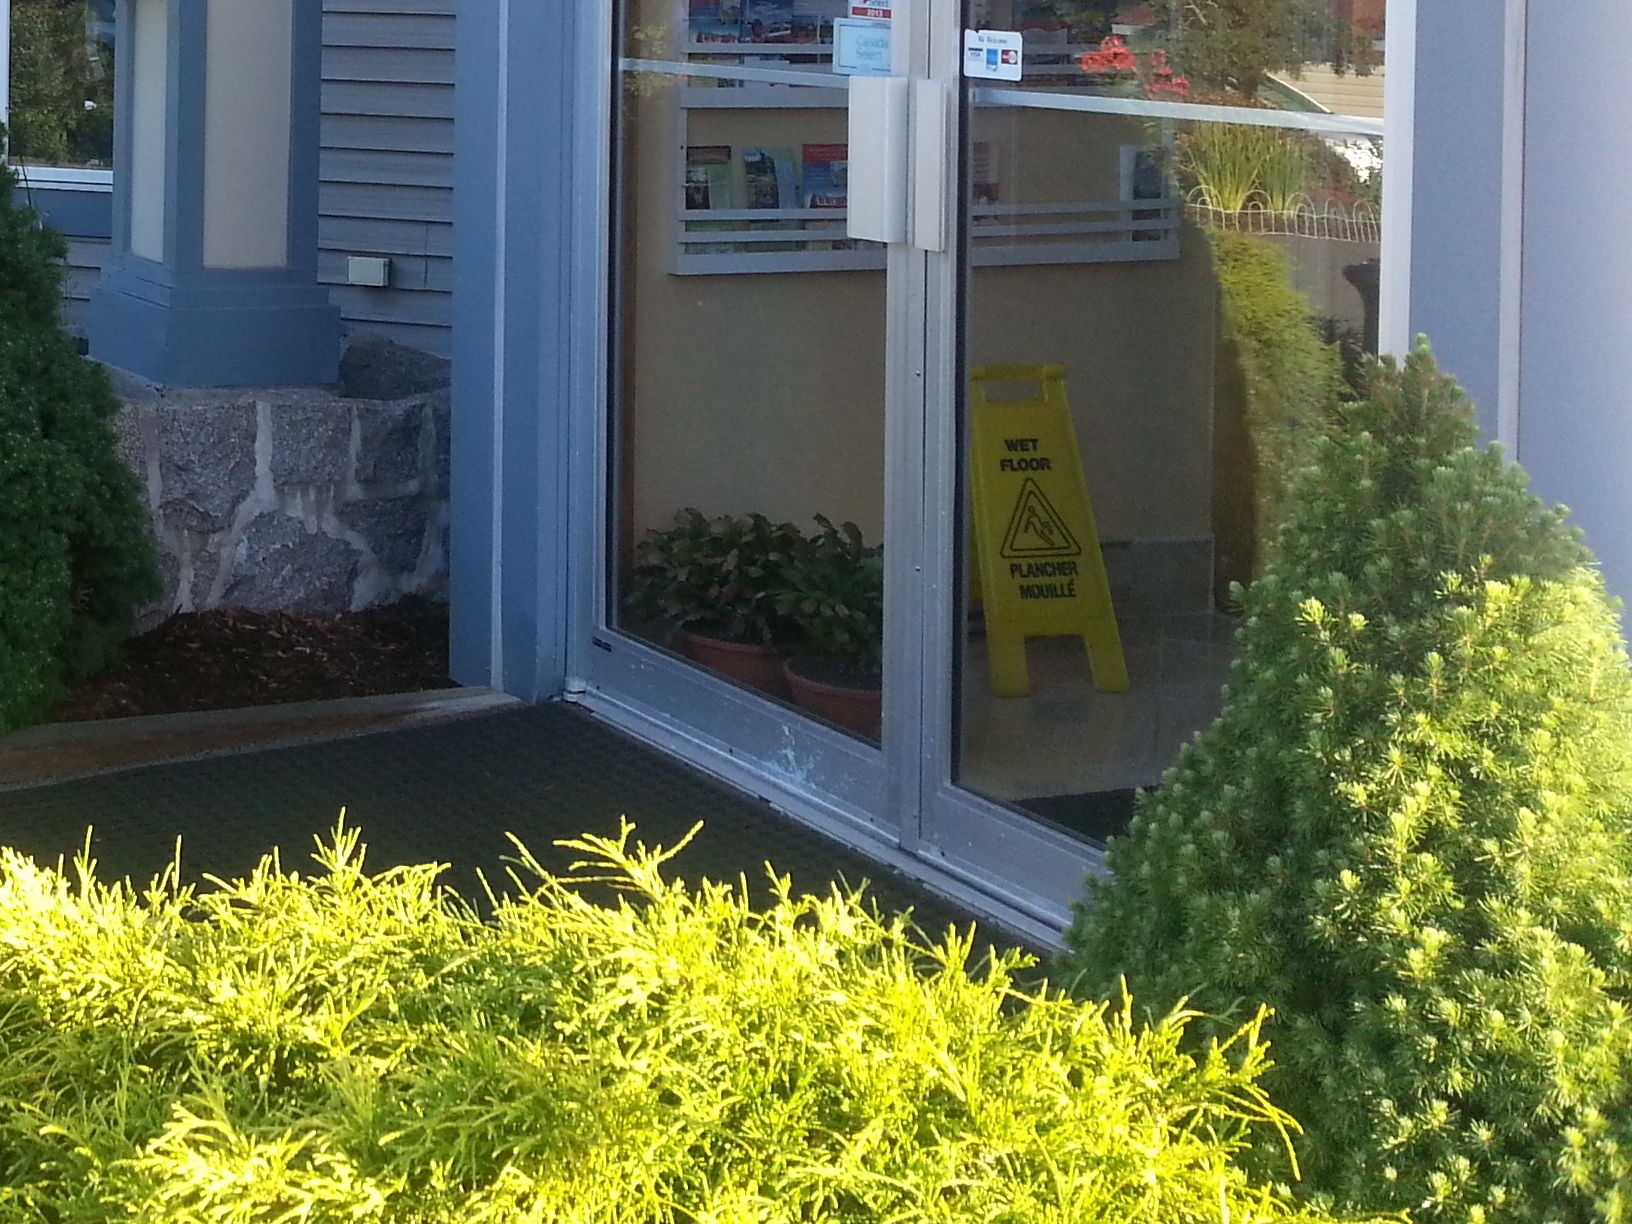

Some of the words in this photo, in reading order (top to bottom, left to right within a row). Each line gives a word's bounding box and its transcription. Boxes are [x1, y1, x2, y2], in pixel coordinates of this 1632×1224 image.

[1004, 438, 1039, 452] WET
[1000, 457, 1052, 472] FLOOR
[1010, 561, 1079, 579] PLANCHER
[1019, 579, 1077, 599] MOUILLÉ
